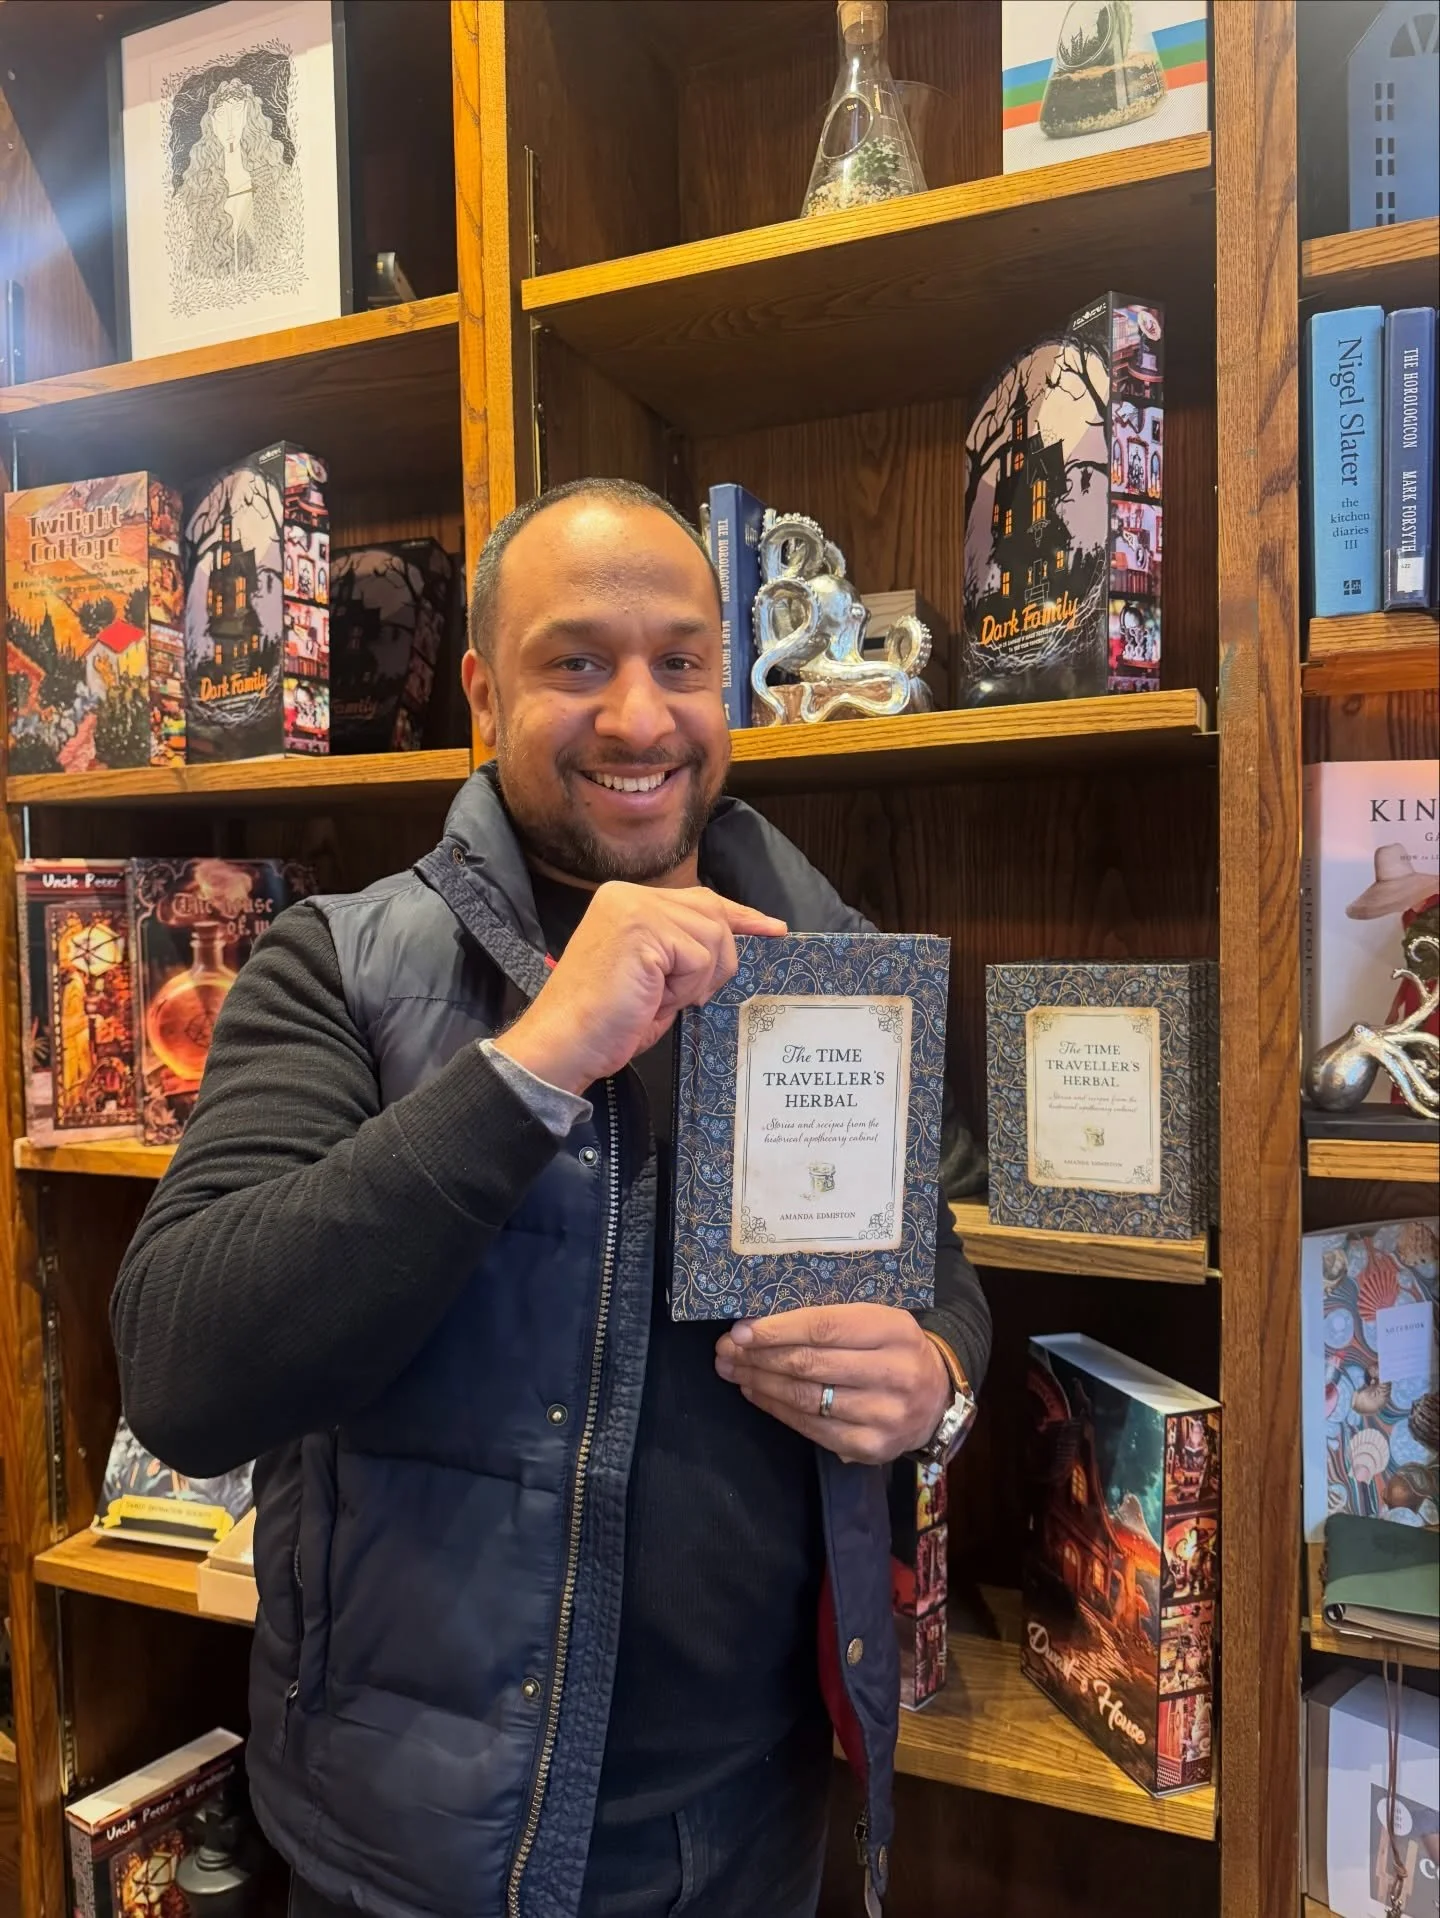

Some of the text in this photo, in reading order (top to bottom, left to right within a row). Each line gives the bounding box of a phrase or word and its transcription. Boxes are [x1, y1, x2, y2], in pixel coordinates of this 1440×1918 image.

[1329, 336, 1366, 486] Nigel Slater
[1401, 347, 1419, 552] THE HOROLOGICON MARK FORSYTH
[1341, 497, 1360, 509] the
[26, 503, 122, 539] Twilight
[1330, 511, 1370, 524] kitchen
[717, 518, 729, 536] THE
[1332, 525, 1369, 538] diaries
[29, 536, 120, 566] Cottage
[981, 608, 1020, 646] Dark
[1021, 590, 1079, 631] Family
[721, 648, 732, 688] FORSYTH
[199, 666, 269, 702] Dark Family
[1368, 798, 1437, 822] KIN
[42, 873, 79, 889] Uncle
[782, 1044, 862, 1064] The TIME
[1058, 1041, 1121, 1056] The TIME
[1045, 1059, 1141, 1073] TRAVELLER'S
[762, 1070, 885, 1086] TRAVELLER'S
[1062, 1075, 1120, 1088] HERBAL
[784, 1093, 858, 1108] HERBAL
[764, 1118, 880, 1133] Stories and recipes from the
[764, 1131, 879, 1149] historical apothecary cabinet
[780, 1211, 856, 1221] AMANDA EDMISTON
[1092, 1679, 1147, 1746] House
[106, 1818, 137, 1842] Uncle
